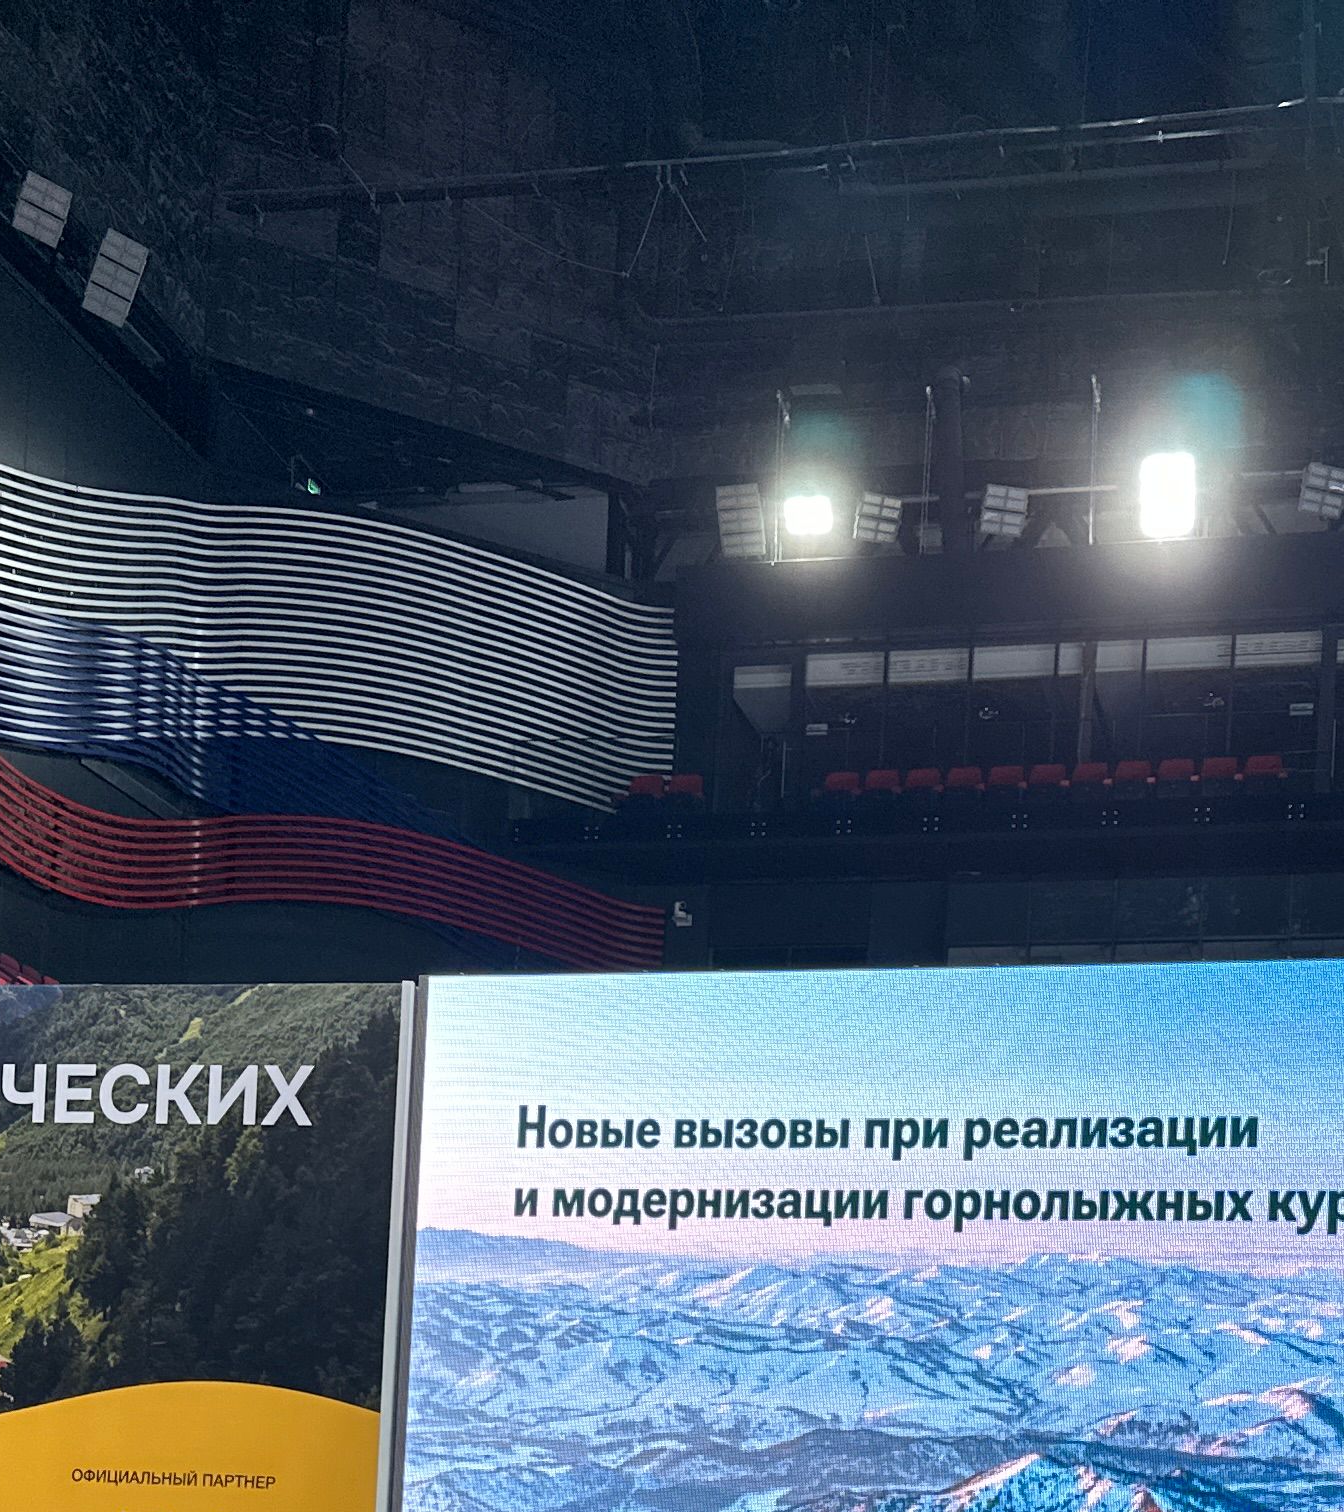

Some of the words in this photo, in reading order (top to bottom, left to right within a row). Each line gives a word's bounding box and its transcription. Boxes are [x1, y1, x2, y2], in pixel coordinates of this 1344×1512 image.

[517, 1104, 661, 1150] Новые
[673, 1112, 851, 1150] вызовы
[863, 1112, 949, 1161] при
[962, 1110, 1257, 1160] реализации
[514, 1188, 538, 1218] и
[551, 1184, 888, 1228] модернизации
[902, 1182, 1253, 1231] горнолыжных
[71, 1468, 198, 1488] ОФИЦИАЛЬНЫЙ
[202, 1474, 276, 1490] ПАРТНЕР
